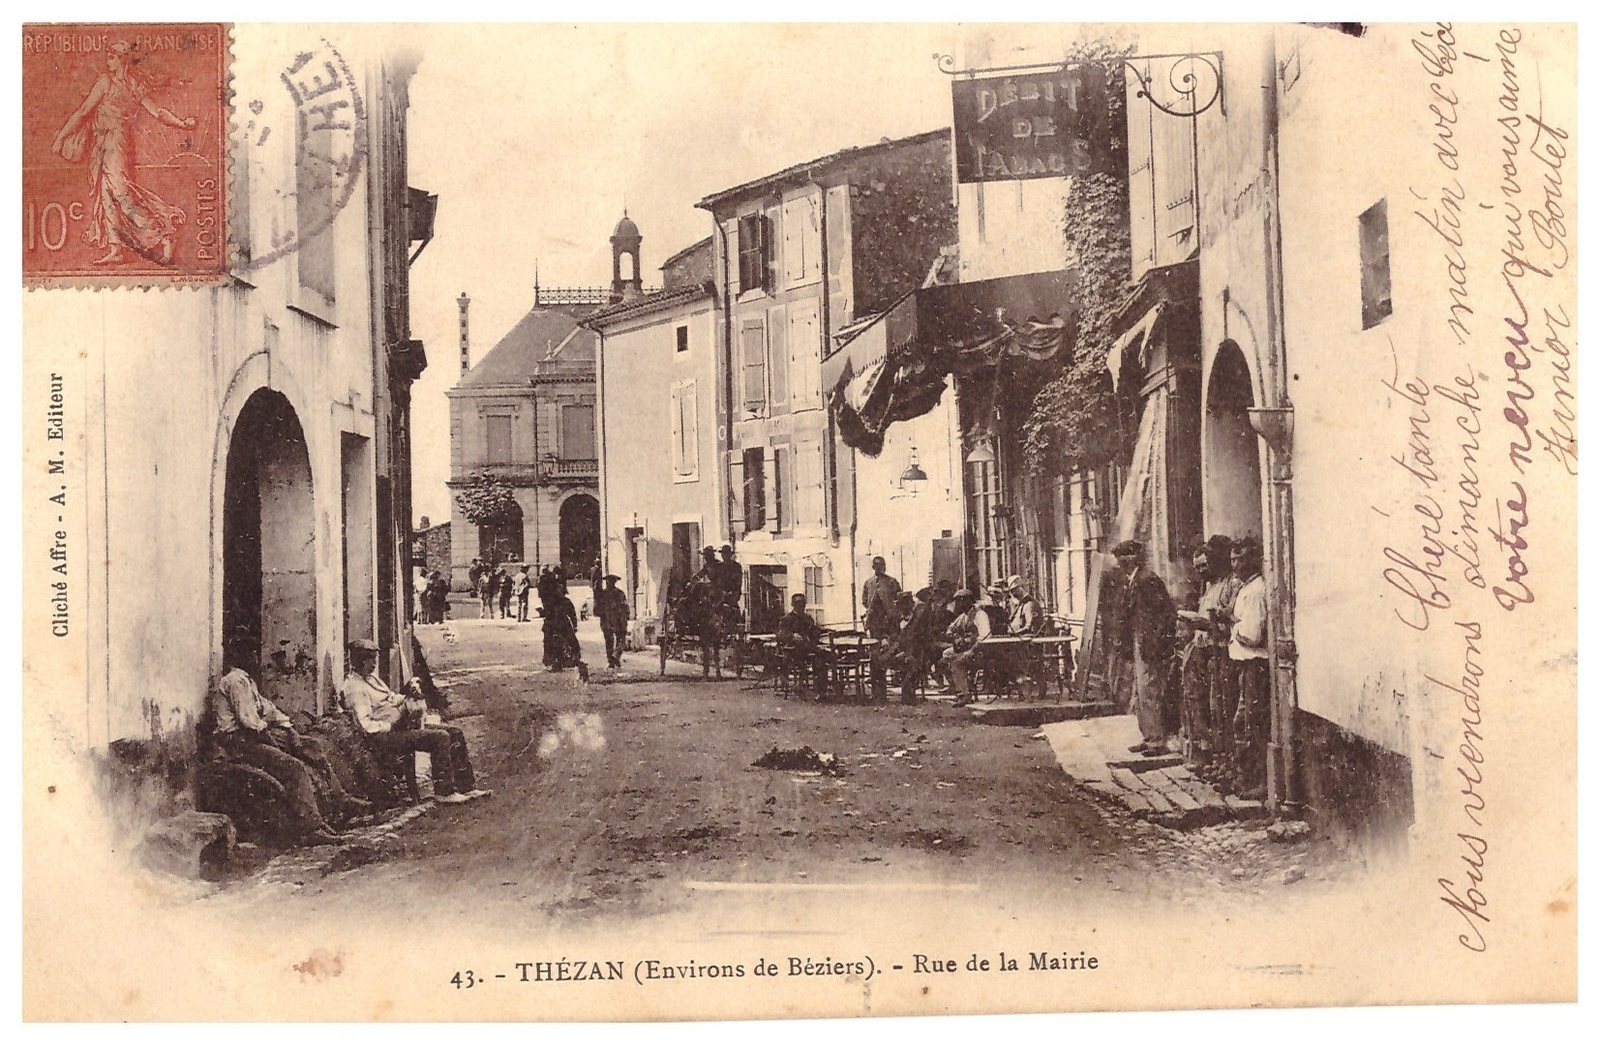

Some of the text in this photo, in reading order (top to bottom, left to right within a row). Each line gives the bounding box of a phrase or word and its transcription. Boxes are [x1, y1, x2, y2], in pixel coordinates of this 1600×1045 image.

[1012, 116, 1058, 138] DE
[1429, 82, 1458, 170] avec
[1497, 116, 1522, 198] vous
[197, 178, 215, 261] POSTES
[1480, 202, 1553, 278] qui
[1409, 178, 1475, 346] matin
[47, 372, 64, 442] Editeur
[1501, 272, 1535, 475] neveu
[48, 450, 65, 475] M.
[48, 485, 67, 506] A.
[1432, 363, 1486, 589] dimanche
[50, 529, 68, 576] Affre
[1488, 481, 1535, 611] Votre
[52, 580, 69, 638] Cliché
[1424, 620, 1487, 828] viendrons
[1438, 832, 1491, 953] Nous
[450, 969, 485, 990] 43.
[515, 956, 625, 982] THÉZAN
[634, 959, 746, 986] (Environs
[753, 957, 779, 977] de
[788, 955, 883, 981] Béziers).
[912, 954, 958, 974] Rue
[966, 953, 990, 972] de
[999, 951, 1019, 972] la
[1028, 951, 1100, 971] Mairie
